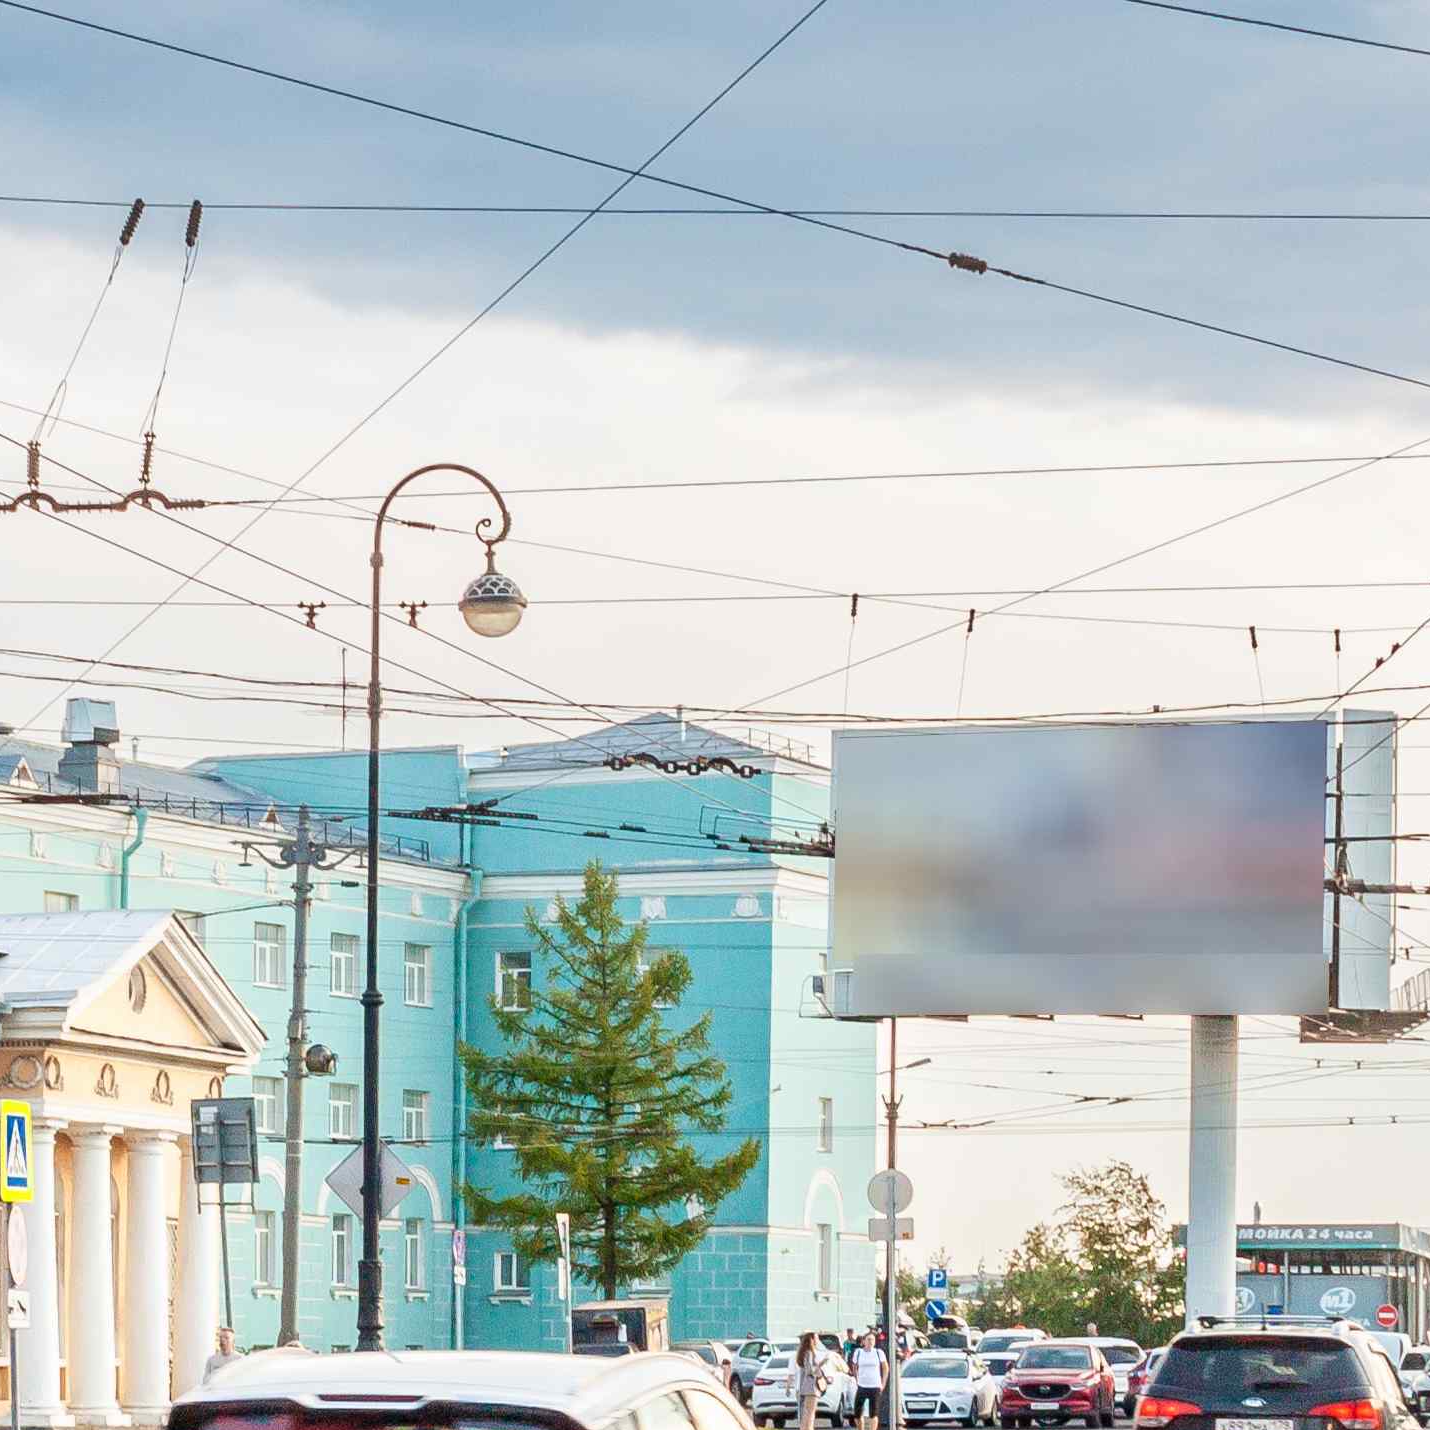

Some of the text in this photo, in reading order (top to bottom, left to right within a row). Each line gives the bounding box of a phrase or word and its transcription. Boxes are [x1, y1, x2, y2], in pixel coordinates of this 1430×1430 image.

[1306, 1228, 1330, 1240] 24
[1334, 1229, 1373, 1240] часа
[932, 1271, 944, 1286] P
